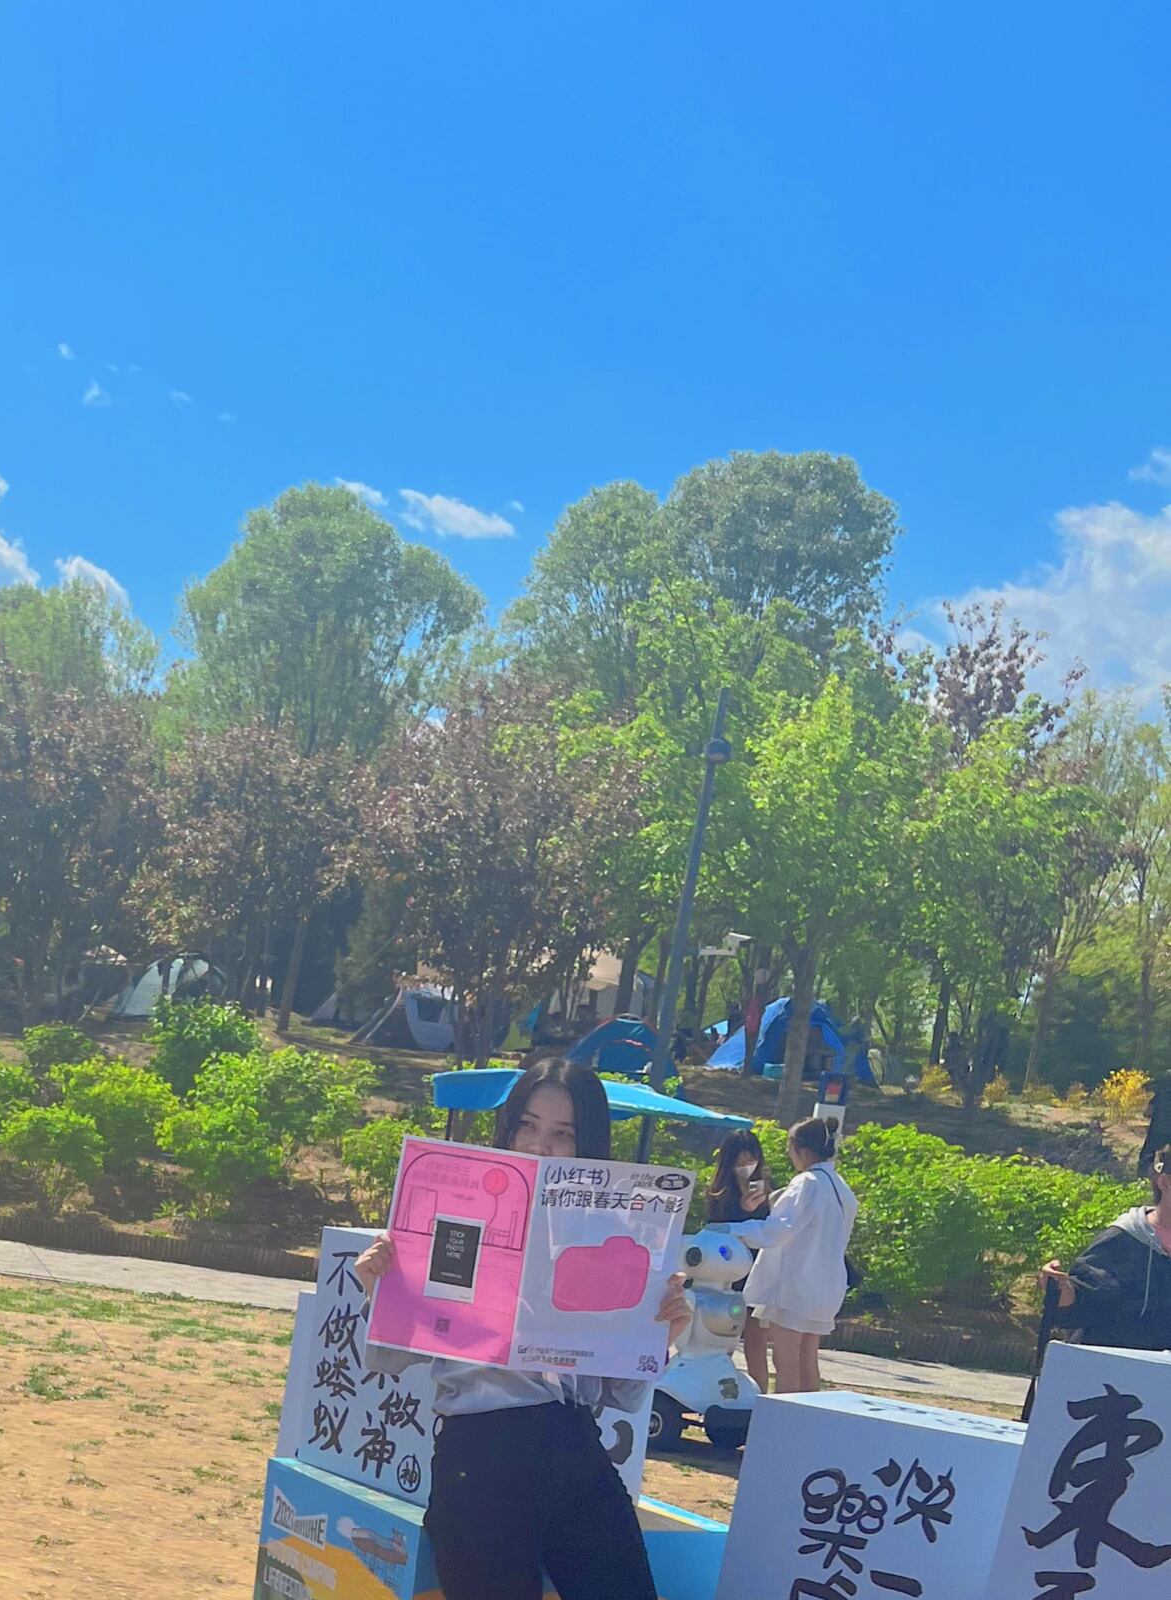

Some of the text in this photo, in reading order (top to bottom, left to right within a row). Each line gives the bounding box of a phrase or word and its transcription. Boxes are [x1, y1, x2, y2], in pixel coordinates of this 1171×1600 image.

[541, 1188, 684, 1213] 请你跟春天合个影
